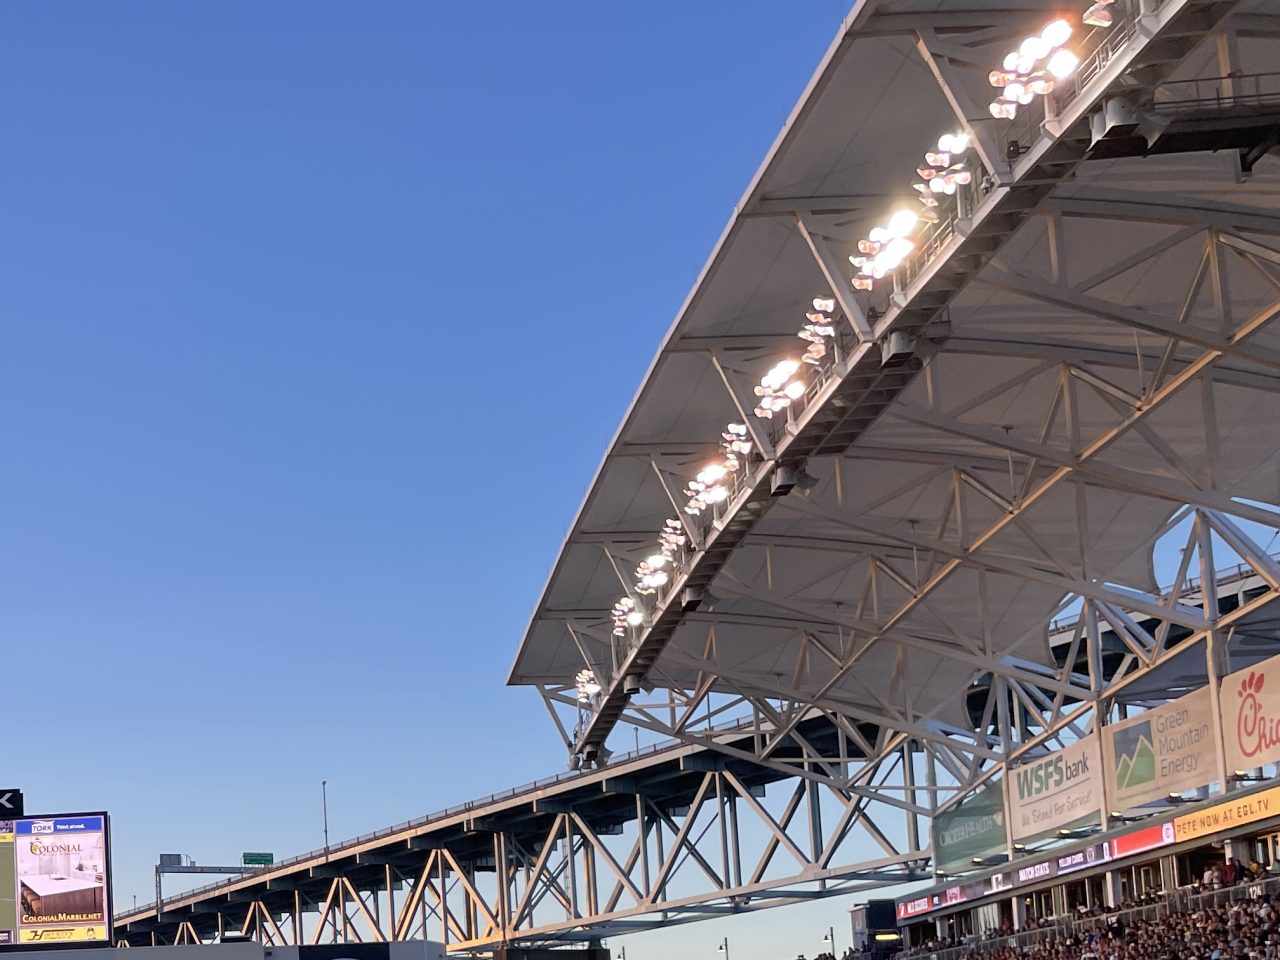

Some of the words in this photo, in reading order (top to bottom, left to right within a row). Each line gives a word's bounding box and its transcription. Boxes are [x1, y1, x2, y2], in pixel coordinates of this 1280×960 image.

[1156, 708, 1189, 734] Green
[1159, 721, 1209, 755] Mountain
[1017, 755, 1064, 800] WSFS
[1065, 752, 1089, 781] bank
[1161, 752, 1199, 777] Energy
[1177, 819, 1196, 834] PETE
[1200, 813, 1219, 828] NOW
[1223, 808, 1234, 820] AT
[1237, 798, 1269, 818] EGL.TV
[30, 841, 84, 855] COLONIAL
